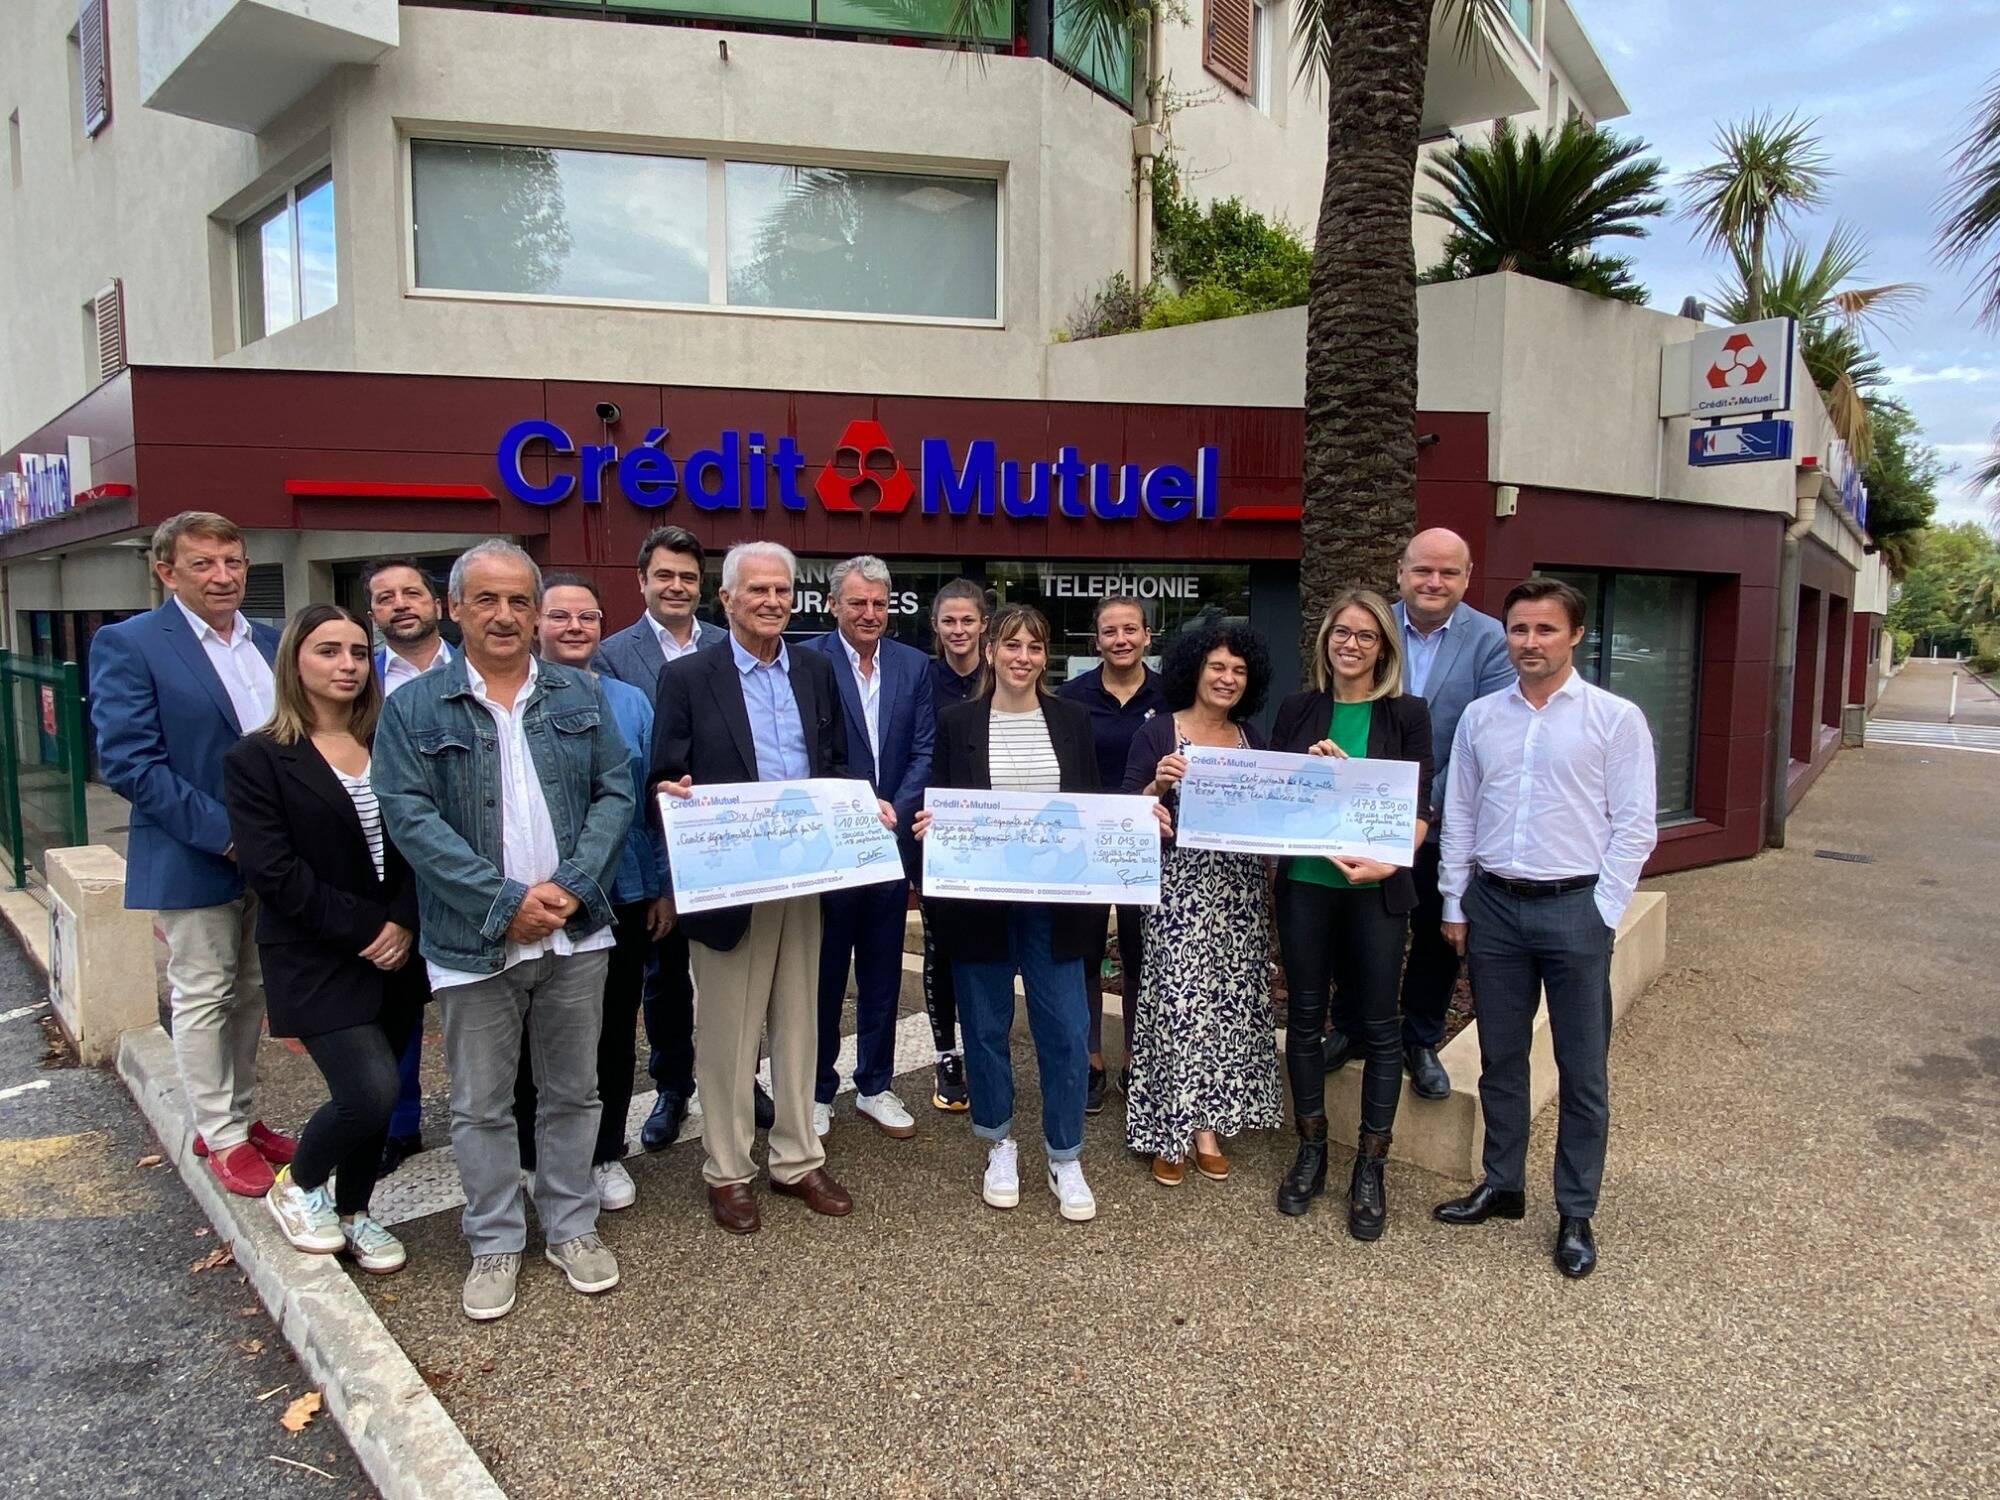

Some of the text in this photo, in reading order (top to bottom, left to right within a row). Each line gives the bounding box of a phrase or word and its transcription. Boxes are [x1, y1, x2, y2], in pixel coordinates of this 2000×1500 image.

[1739, 394, 1773, 405] Mutuel
[498, 419, 1218, 521] Crédit Mutuel
[1040, 574, 1200, 598] TELEPHONIE
[1191, 756, 1256, 769] Crédit Mutuel
[933, 799, 1000, 810] Crédit Mutuel
